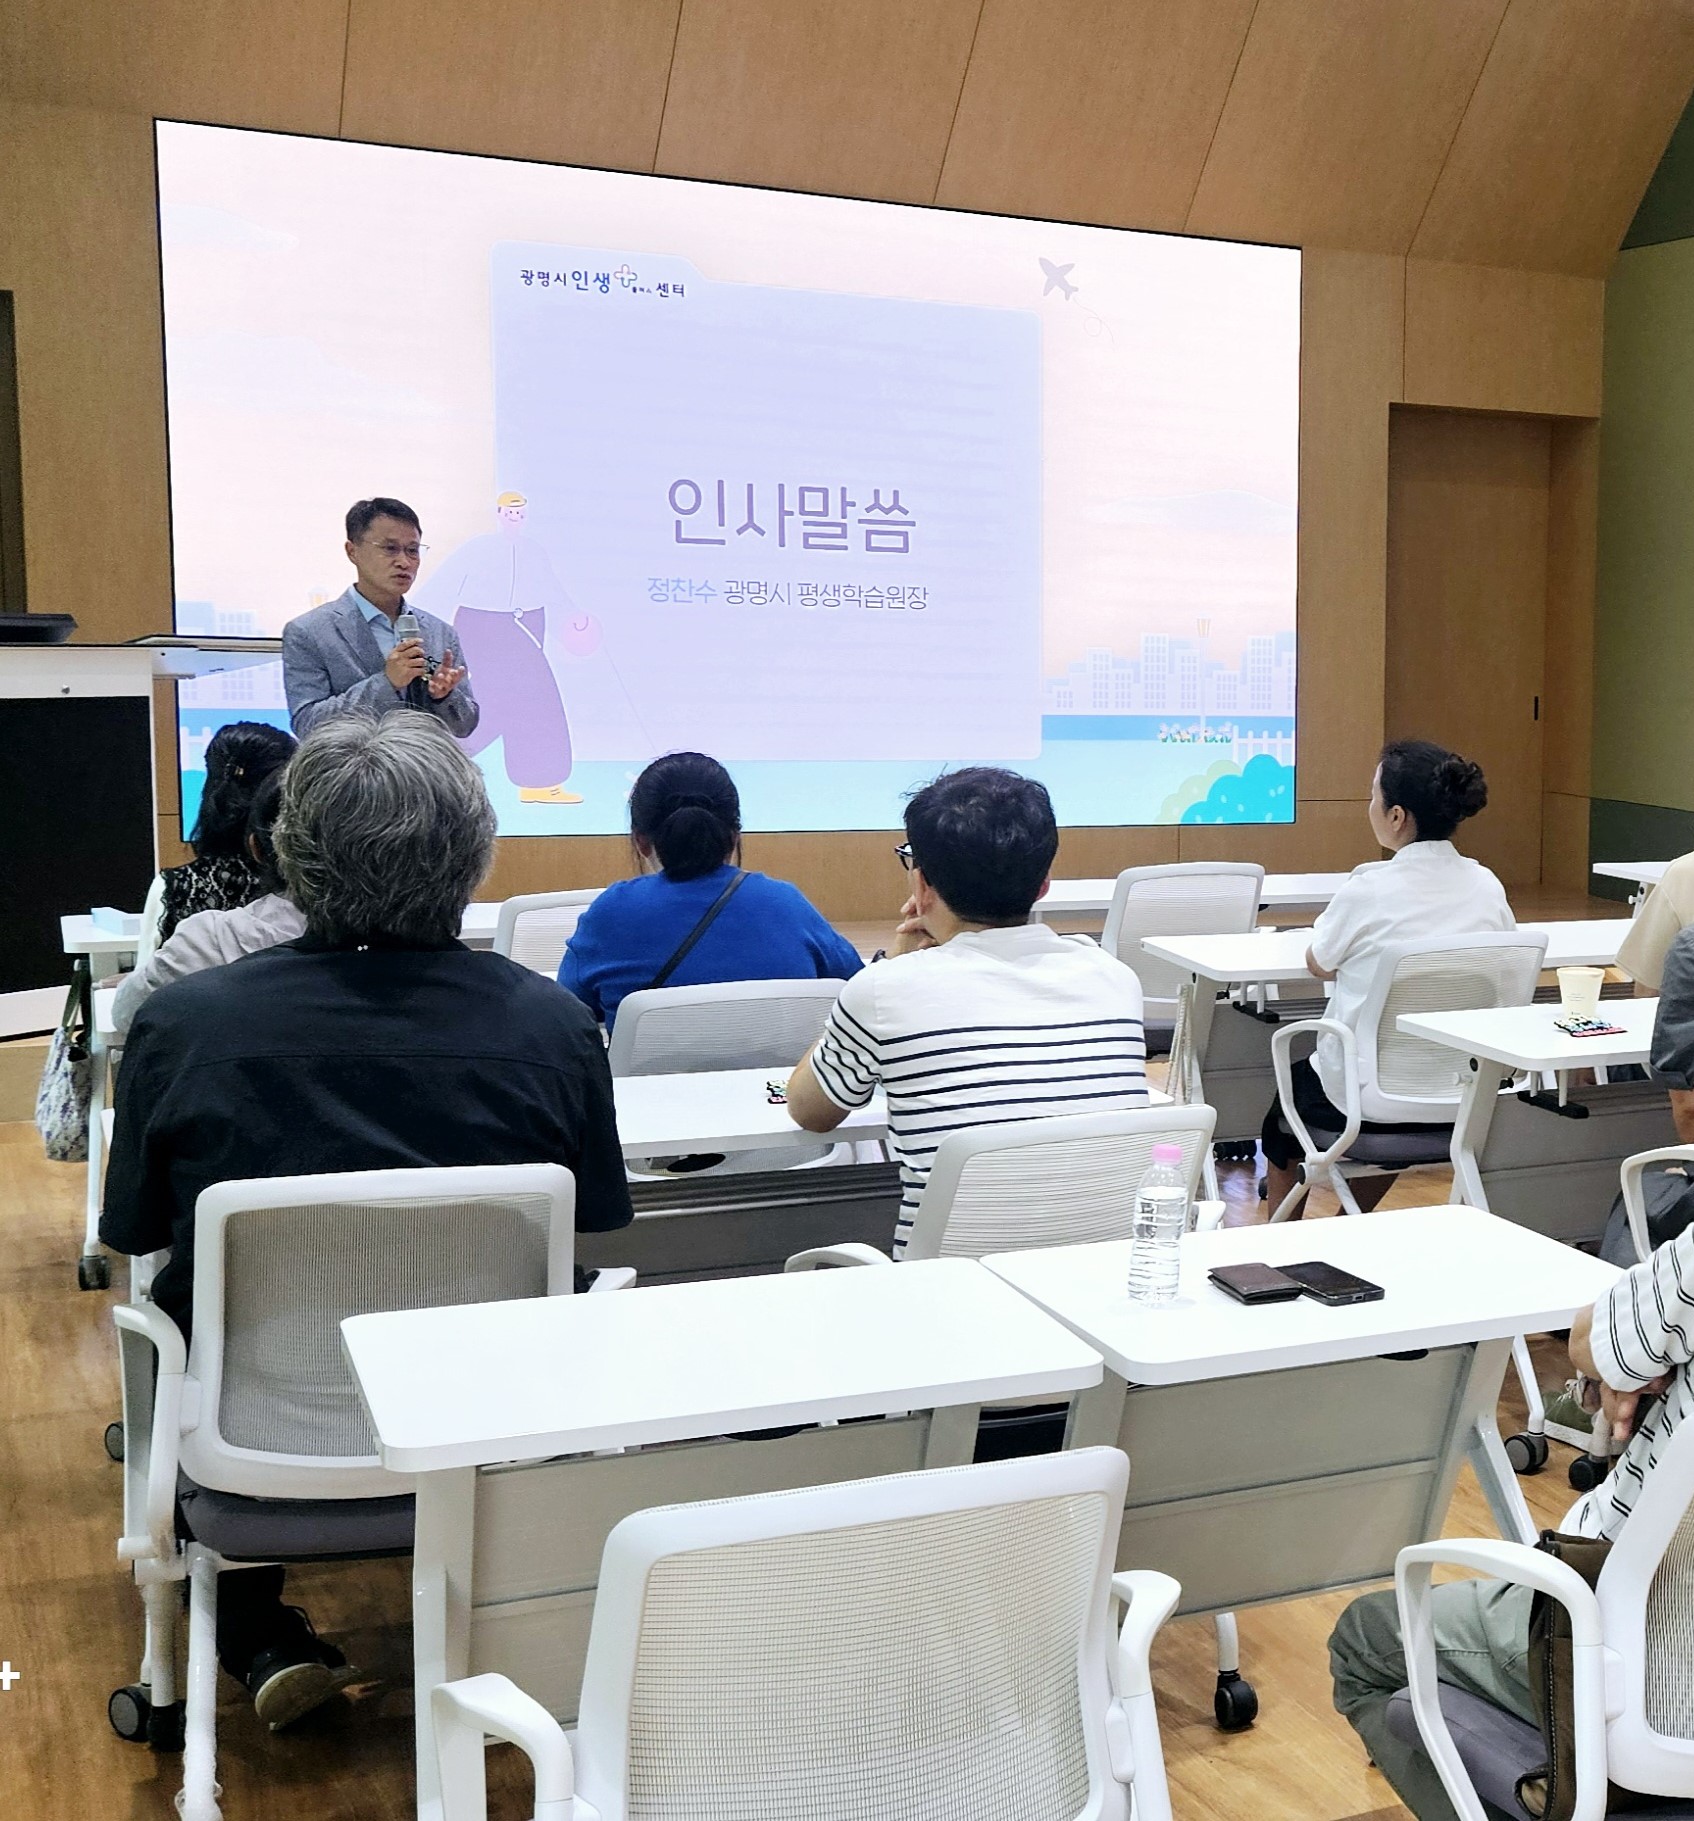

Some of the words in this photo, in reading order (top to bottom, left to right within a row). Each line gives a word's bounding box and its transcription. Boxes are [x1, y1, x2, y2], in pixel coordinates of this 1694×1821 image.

[521, 269, 567, 287] 광명시
[571, 271, 610, 293] 인생
[656, 282, 685, 298] 센터
[669, 479, 916, 553] 인사말씀
[648, 577, 718, 604] 정찬수
[724, 580, 790, 605] 광명시
[797, 583, 929, 610] 평생학습원장
